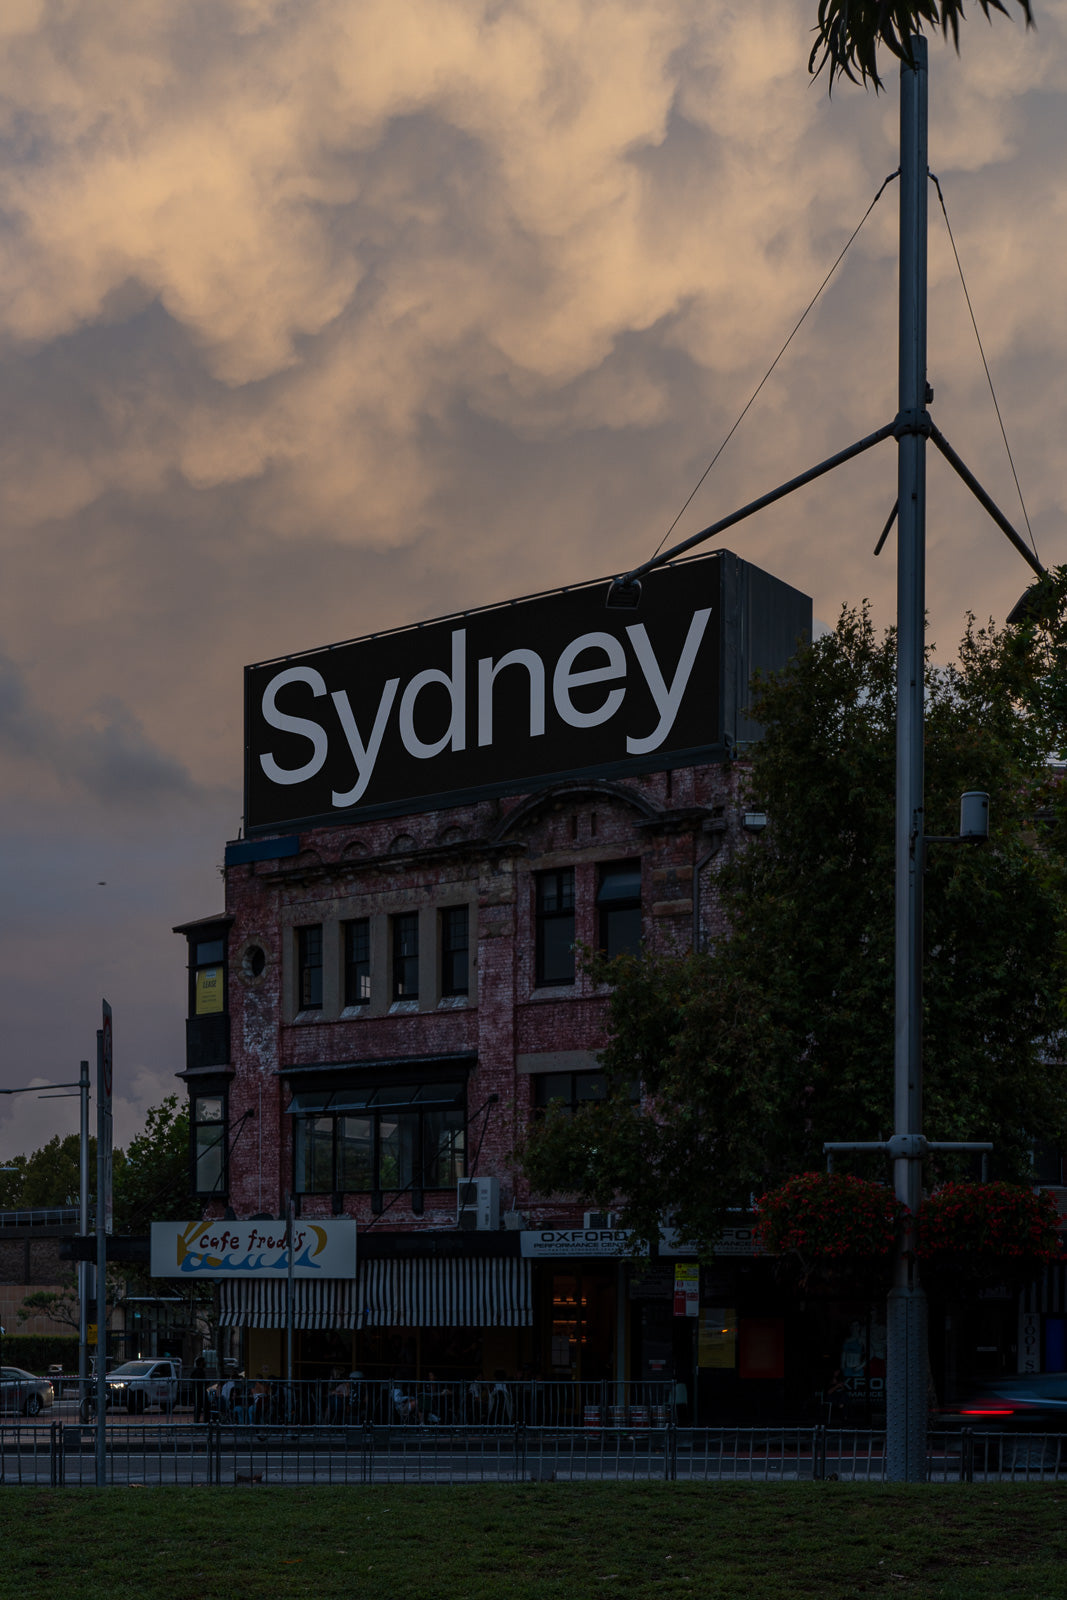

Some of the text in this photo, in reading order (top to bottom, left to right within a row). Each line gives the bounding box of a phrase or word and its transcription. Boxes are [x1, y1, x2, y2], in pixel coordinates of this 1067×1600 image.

[258, 607, 712, 809] Sydney
[199, 1231, 240, 1252] cafe
[541, 1231, 628, 1242] OXFORD
[1024, 1315, 1036, 1370] TOOLS
